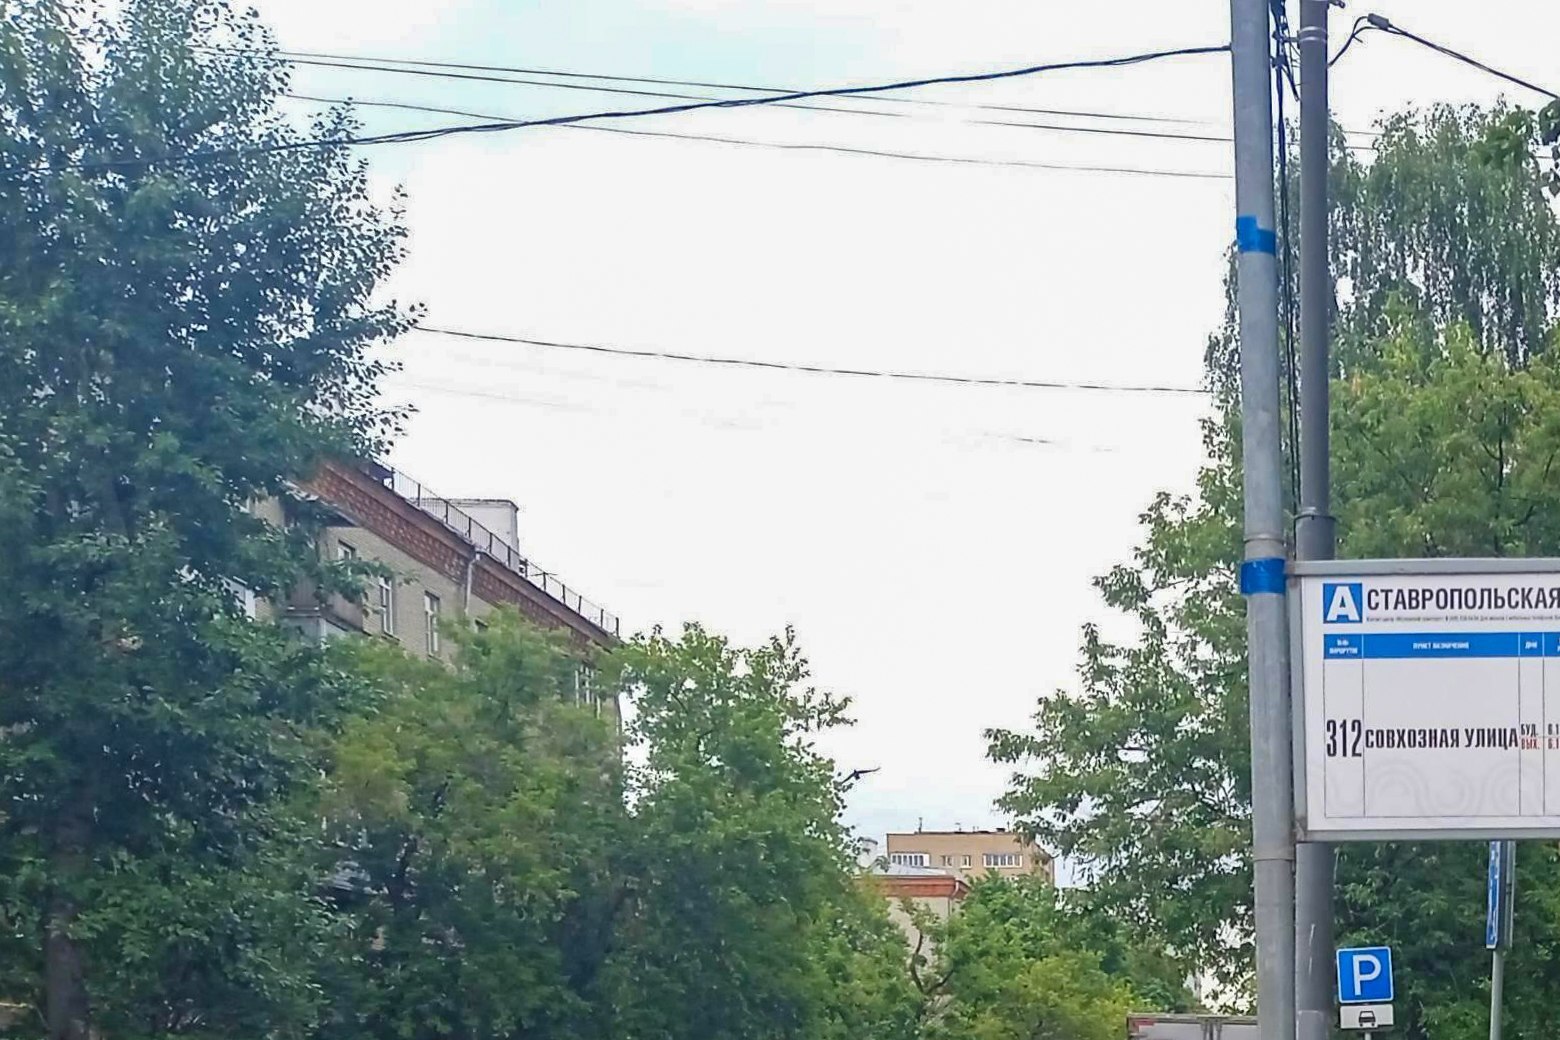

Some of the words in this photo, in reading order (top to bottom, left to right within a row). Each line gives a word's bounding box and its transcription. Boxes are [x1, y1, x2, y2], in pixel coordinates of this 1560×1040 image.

[1326, 719, 1362, 757] 312
[1365, 728, 1460, 749] СОВХОЗНАЯ
[1465, 728, 1519, 751] УЛИЦА
[1352, 954, 1382, 996] P
